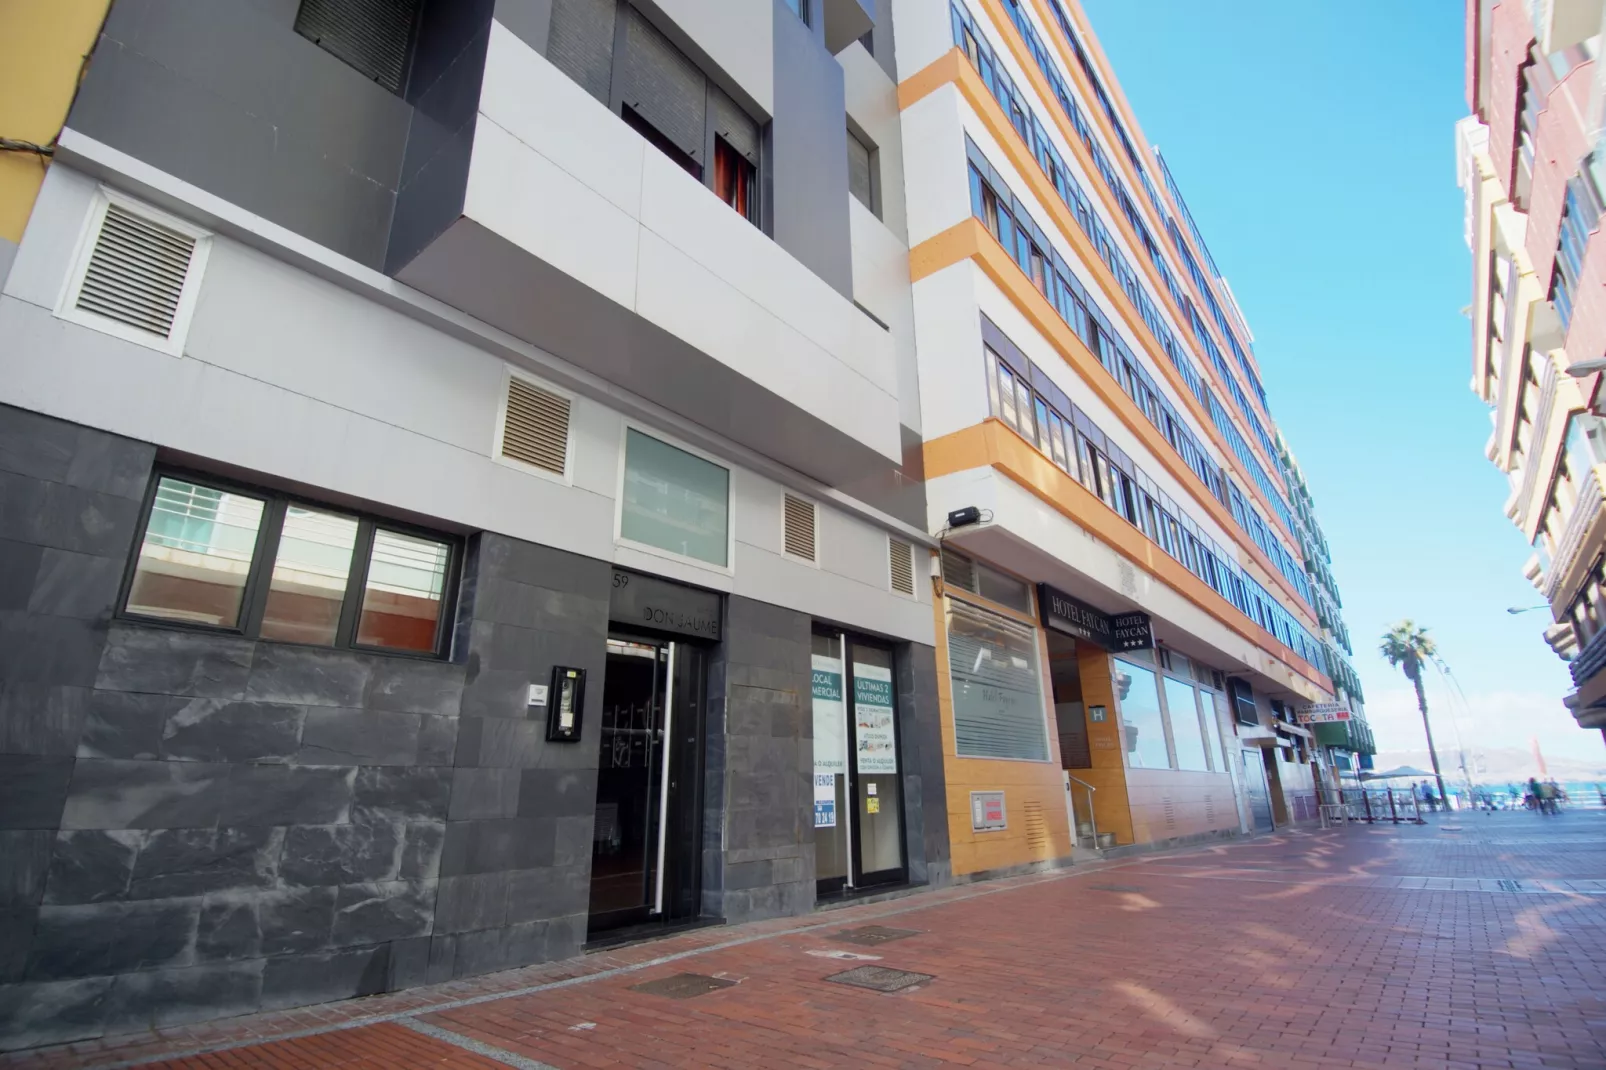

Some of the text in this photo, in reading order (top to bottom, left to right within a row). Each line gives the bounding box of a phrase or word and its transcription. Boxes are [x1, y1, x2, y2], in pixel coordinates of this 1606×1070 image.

[612, 573, 629, 588] 59
[1052, 595, 1081, 623] HOTEL
[643, 606, 675, 625] DON
[677, 613, 718, 634] JAUME
[1115, 615, 1145, 628] HOTEL
[884, 684, 889, 694] 2
[857, 691, 890, 705] VIVIENDAS
[1093, 709, 1103, 720] H
[815, 774, 833, 786] VENDE
